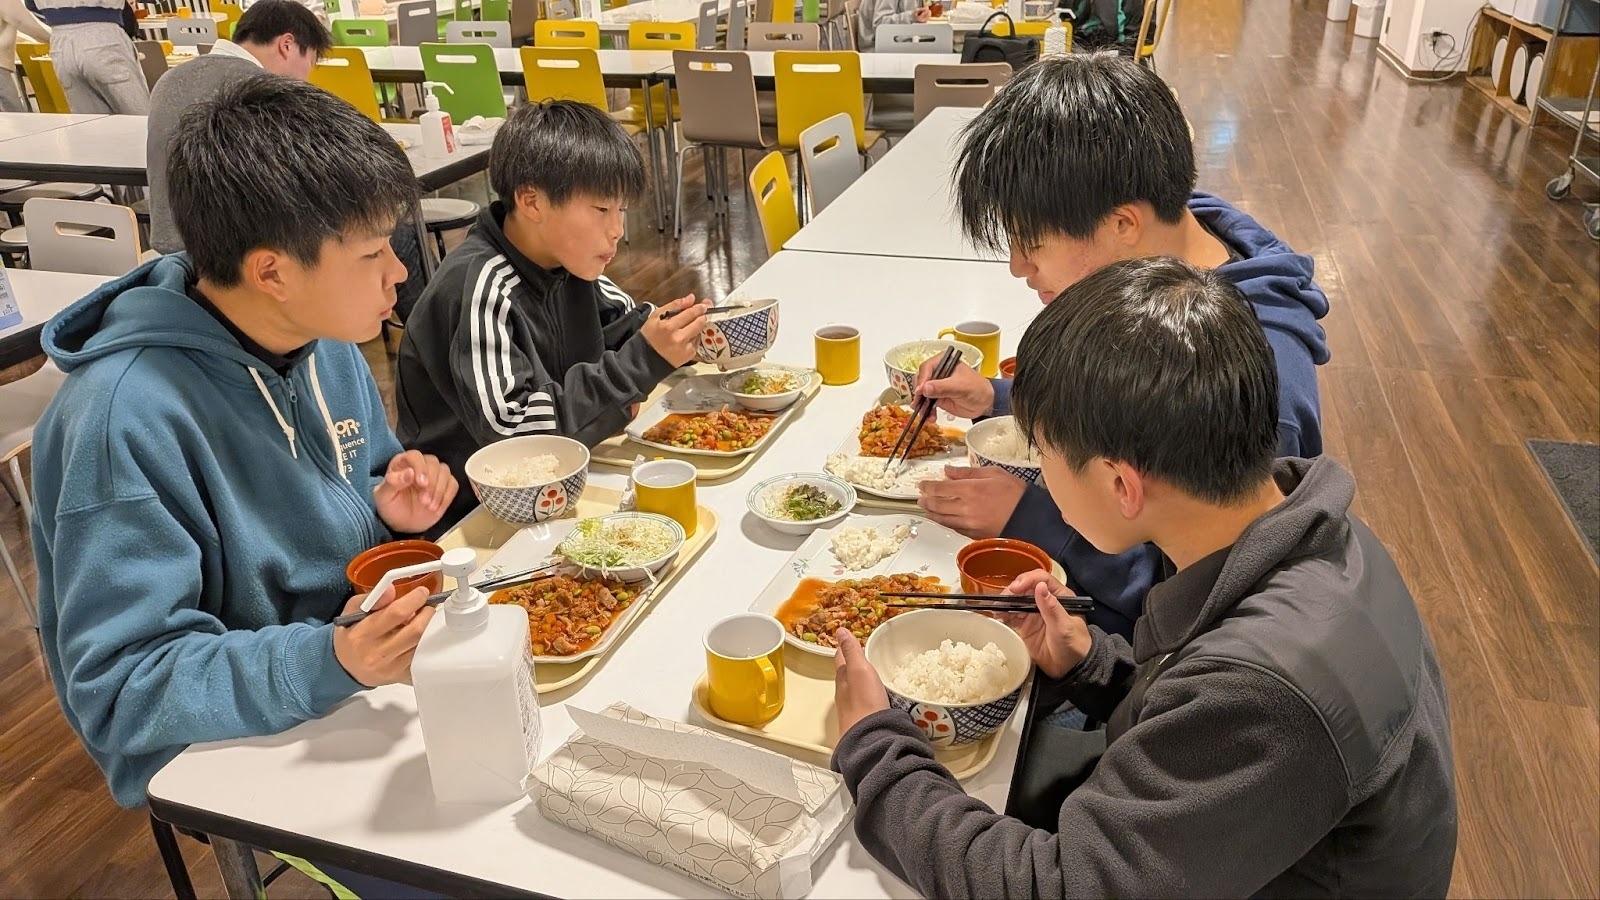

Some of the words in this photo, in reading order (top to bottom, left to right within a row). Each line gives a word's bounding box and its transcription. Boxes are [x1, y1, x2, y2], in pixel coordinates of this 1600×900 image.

[334, 419, 360, 436] OR
[340, 438, 365, 451] quence
[343, 464, 353, 473] 73
